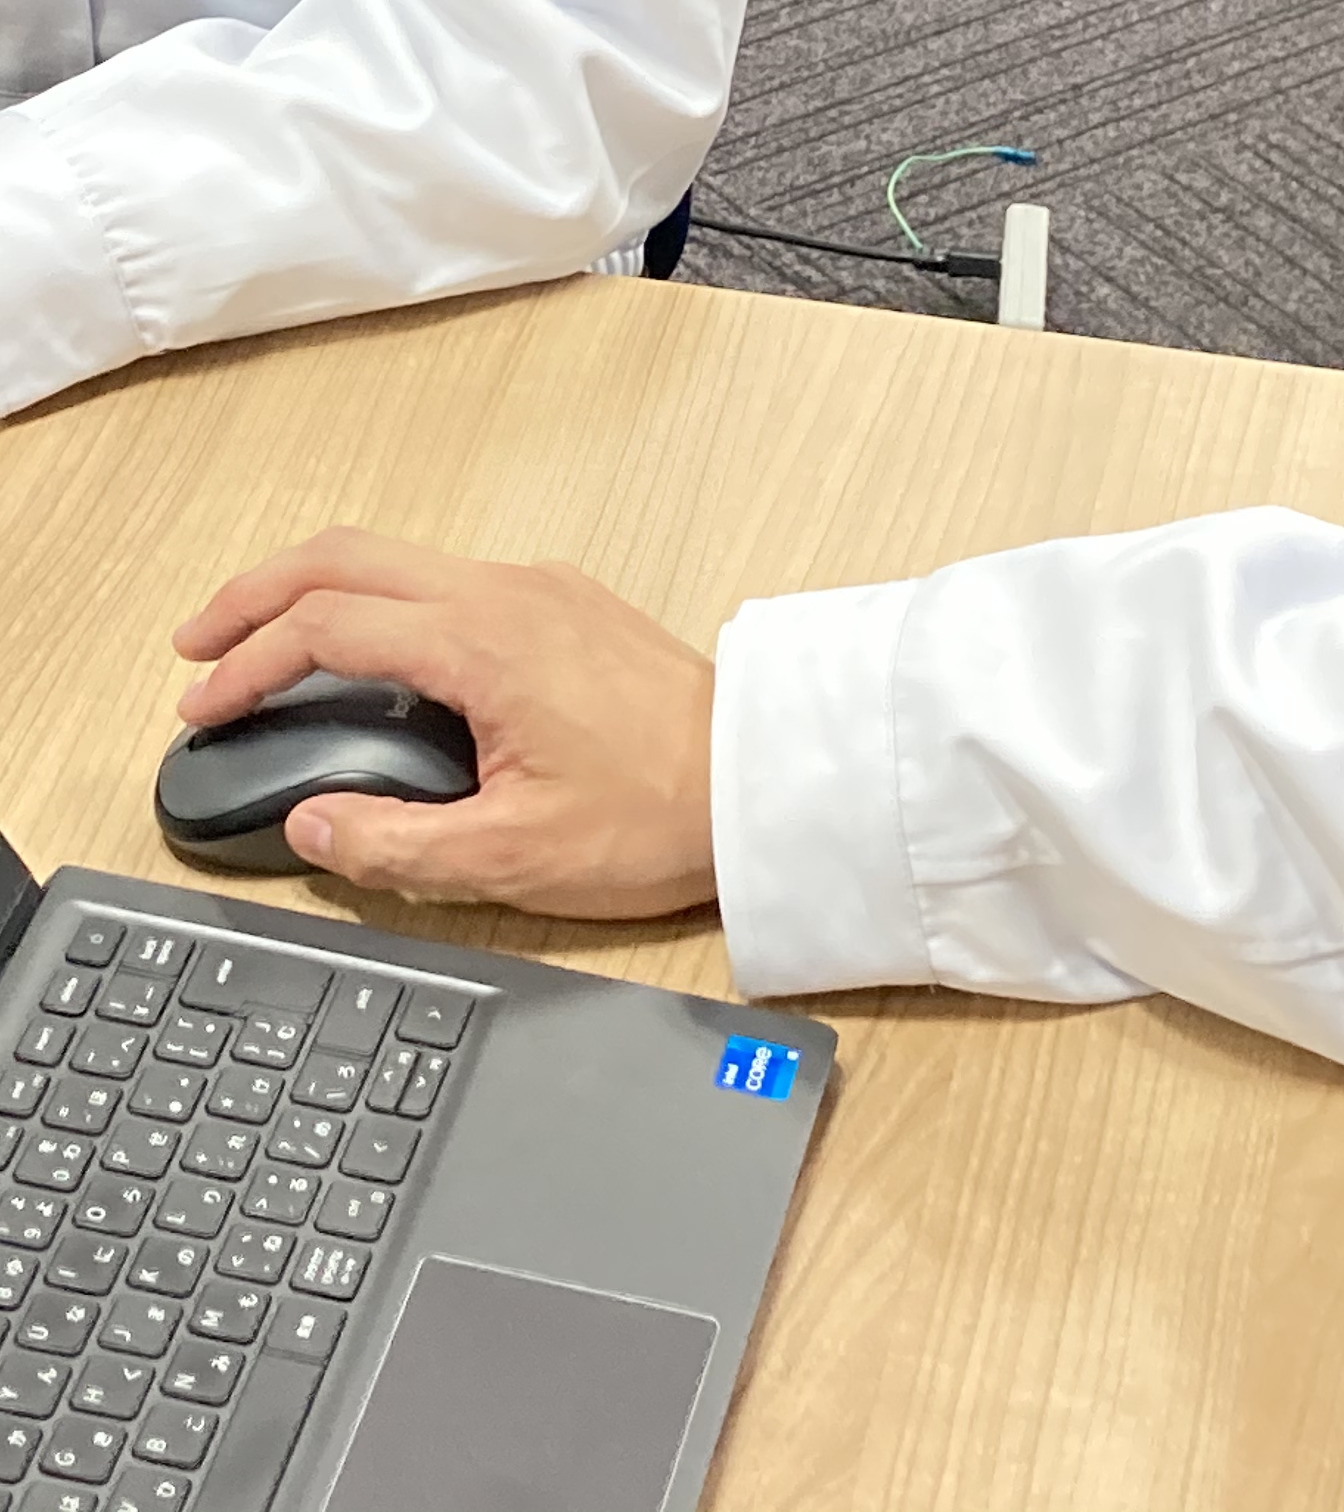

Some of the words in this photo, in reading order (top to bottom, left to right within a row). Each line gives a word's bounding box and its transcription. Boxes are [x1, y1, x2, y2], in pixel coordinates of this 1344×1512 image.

[112, 1150, 130, 1165] P
[166, 1214, 186, 1224] L
[24, 1228, 41, 1239] 9
[138, 1269, 159, 1284] K
[199, 1309, 223, 1330] M
[27, 1325, 49, 1340] U
[114, 1329, 131, 1342] J
[172, 1373, 196, 1390] N
[83, 1387, 104, 1405] H
[143, 1438, 167, 1454] B
[53, 1449, 75, 1466] G
